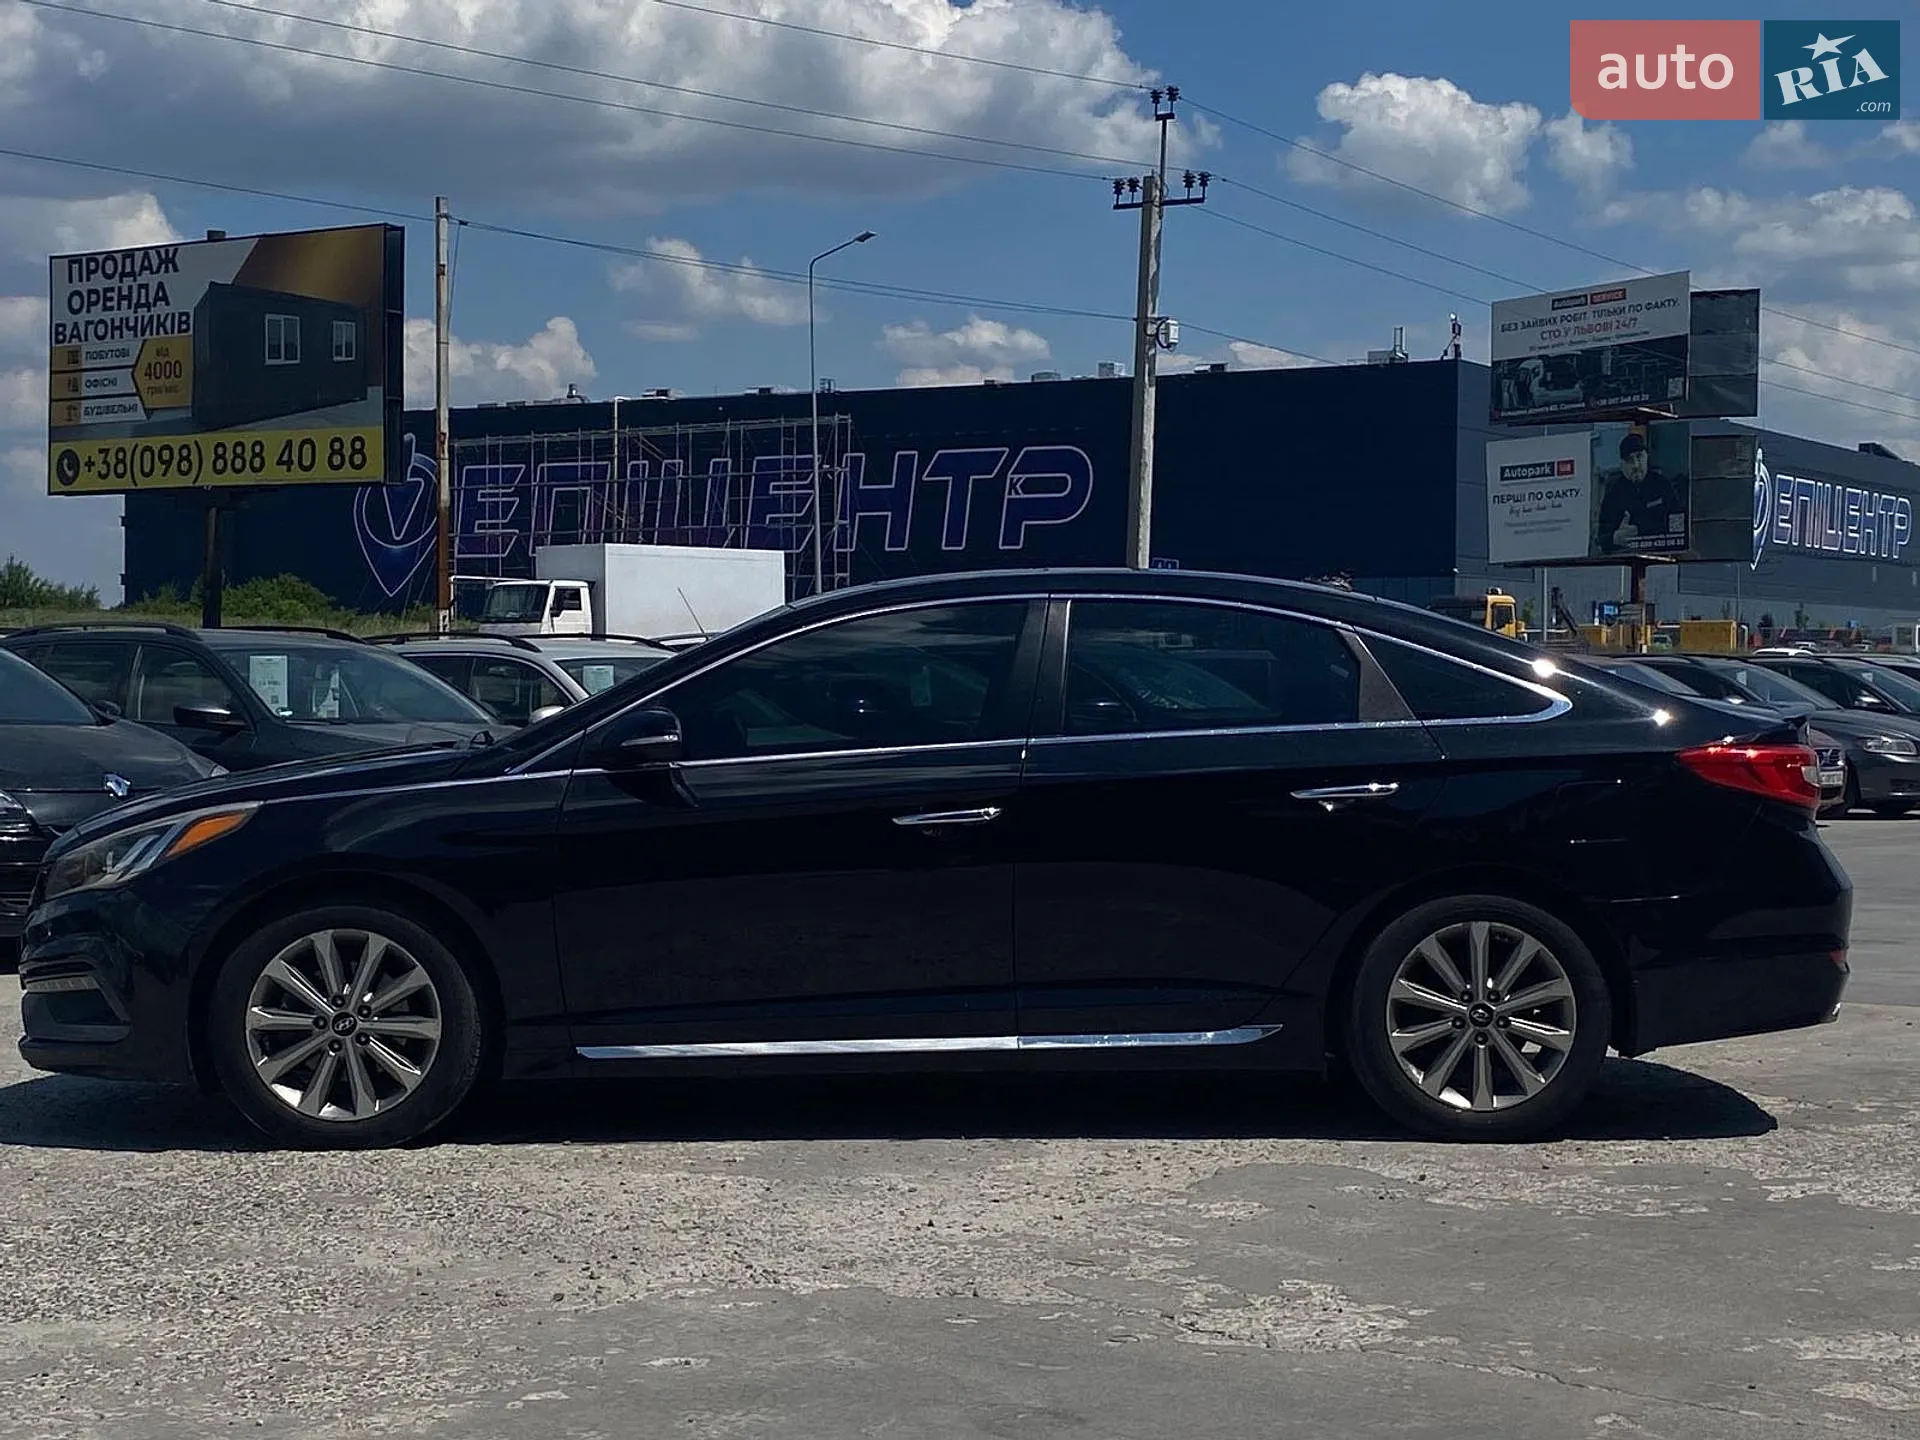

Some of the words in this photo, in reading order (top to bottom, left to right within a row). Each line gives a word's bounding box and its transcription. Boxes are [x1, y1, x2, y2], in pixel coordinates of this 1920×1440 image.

[68, 248, 180, 283] ПРОДАЖ
[67, 281, 170, 315] ОРЕНДА
[1628, 302, 1642, 314] ПО
[54, 311, 191, 344] ВАГОНЧИКІВ
[1540, 327, 1561, 341] СТО
[1615, 317, 1638, 331] 24/7
[85, 347, 130, 360] ПОБУТОВІ
[144, 360, 182, 380] 4000
[85, 377, 118, 389] ОФІСНІ
[84, 403, 138, 417] БУДІВЕЛЬНІ
[83, 439, 204, 487] +38(098)
[211, 440, 265, 475] 888
[276, 437, 317, 472] 40
[327, 435, 367, 472] 88
[1503, 463, 1552, 479] Autopark
[454, 445, 1094, 558] ЕПІЦЕНТР
[1492, 492, 1526, 505] ПЕРШІ
[1528, 490, 1543, 501] ПО
[1772, 474, 1912, 558] ЕПІЦЕНТР
